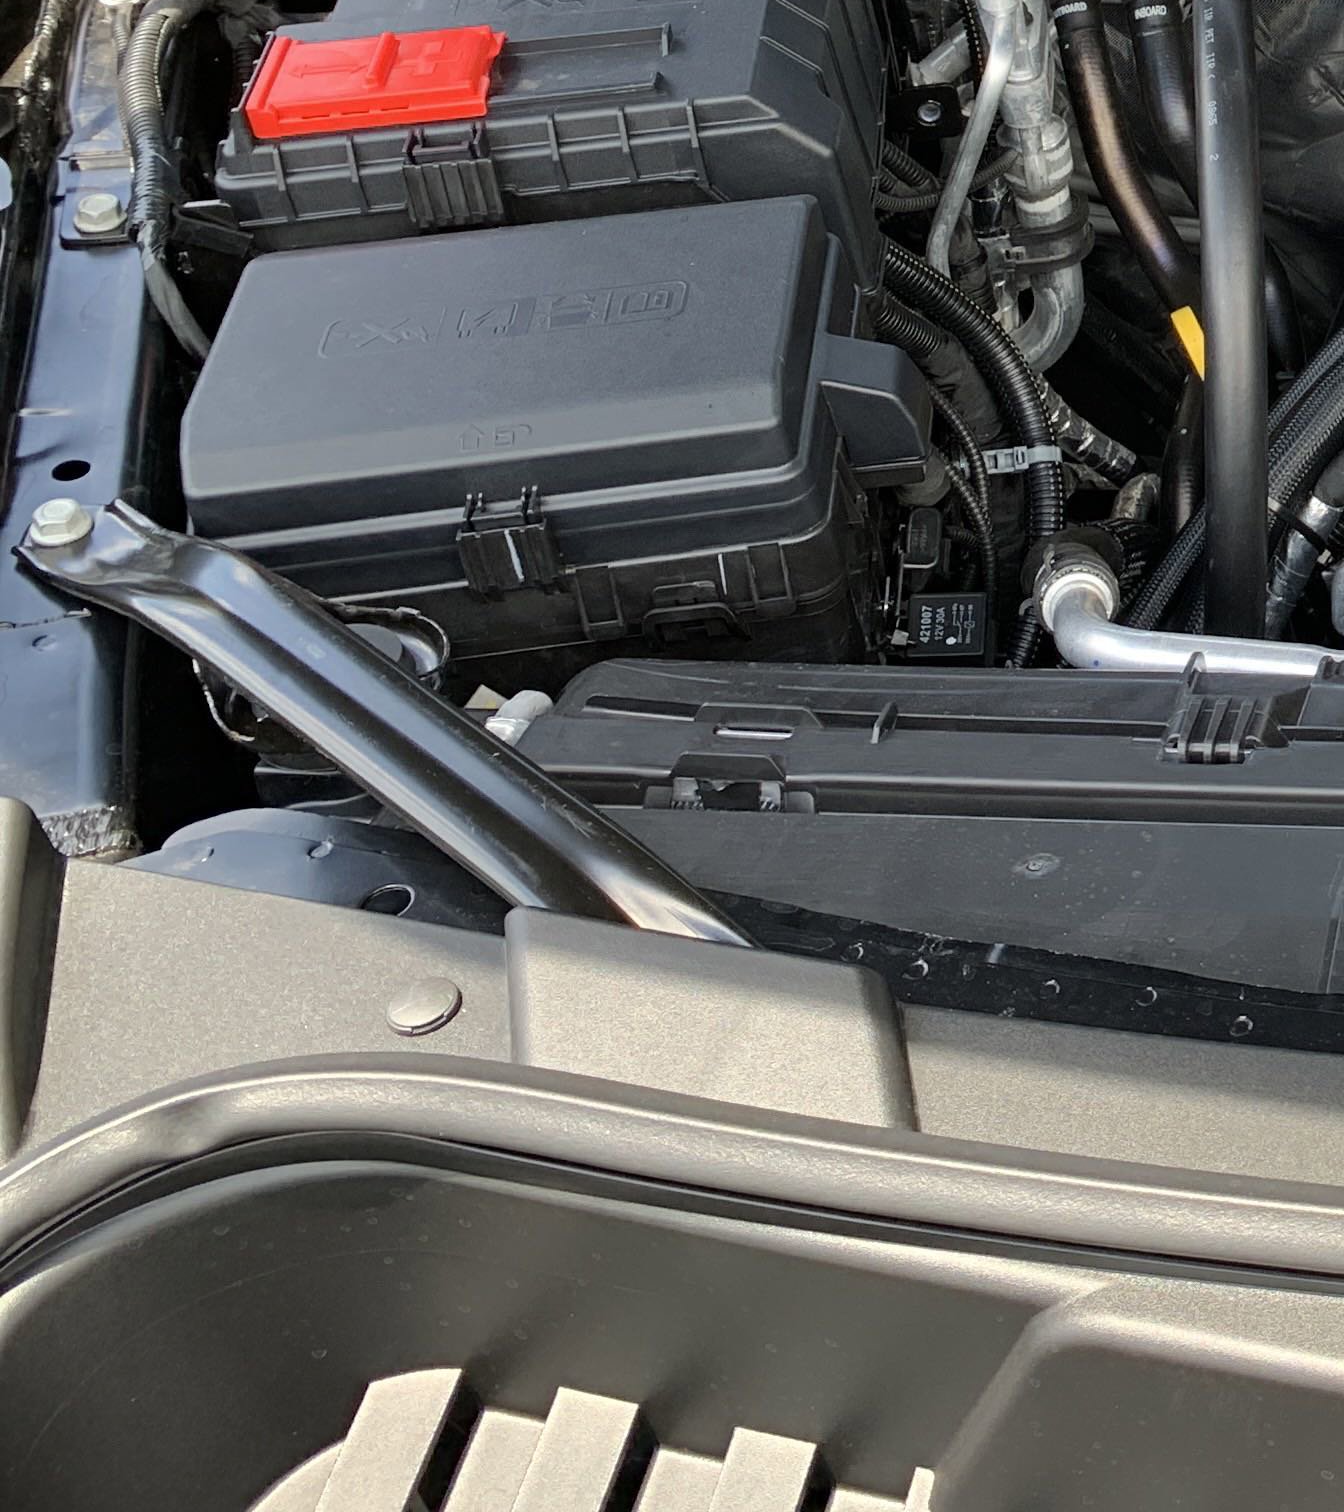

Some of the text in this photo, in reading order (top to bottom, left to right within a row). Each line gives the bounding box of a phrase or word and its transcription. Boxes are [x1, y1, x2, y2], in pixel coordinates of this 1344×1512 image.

[919, 605, 933, 644] 421007
[934, 607, 946, 640] 12V 30A
